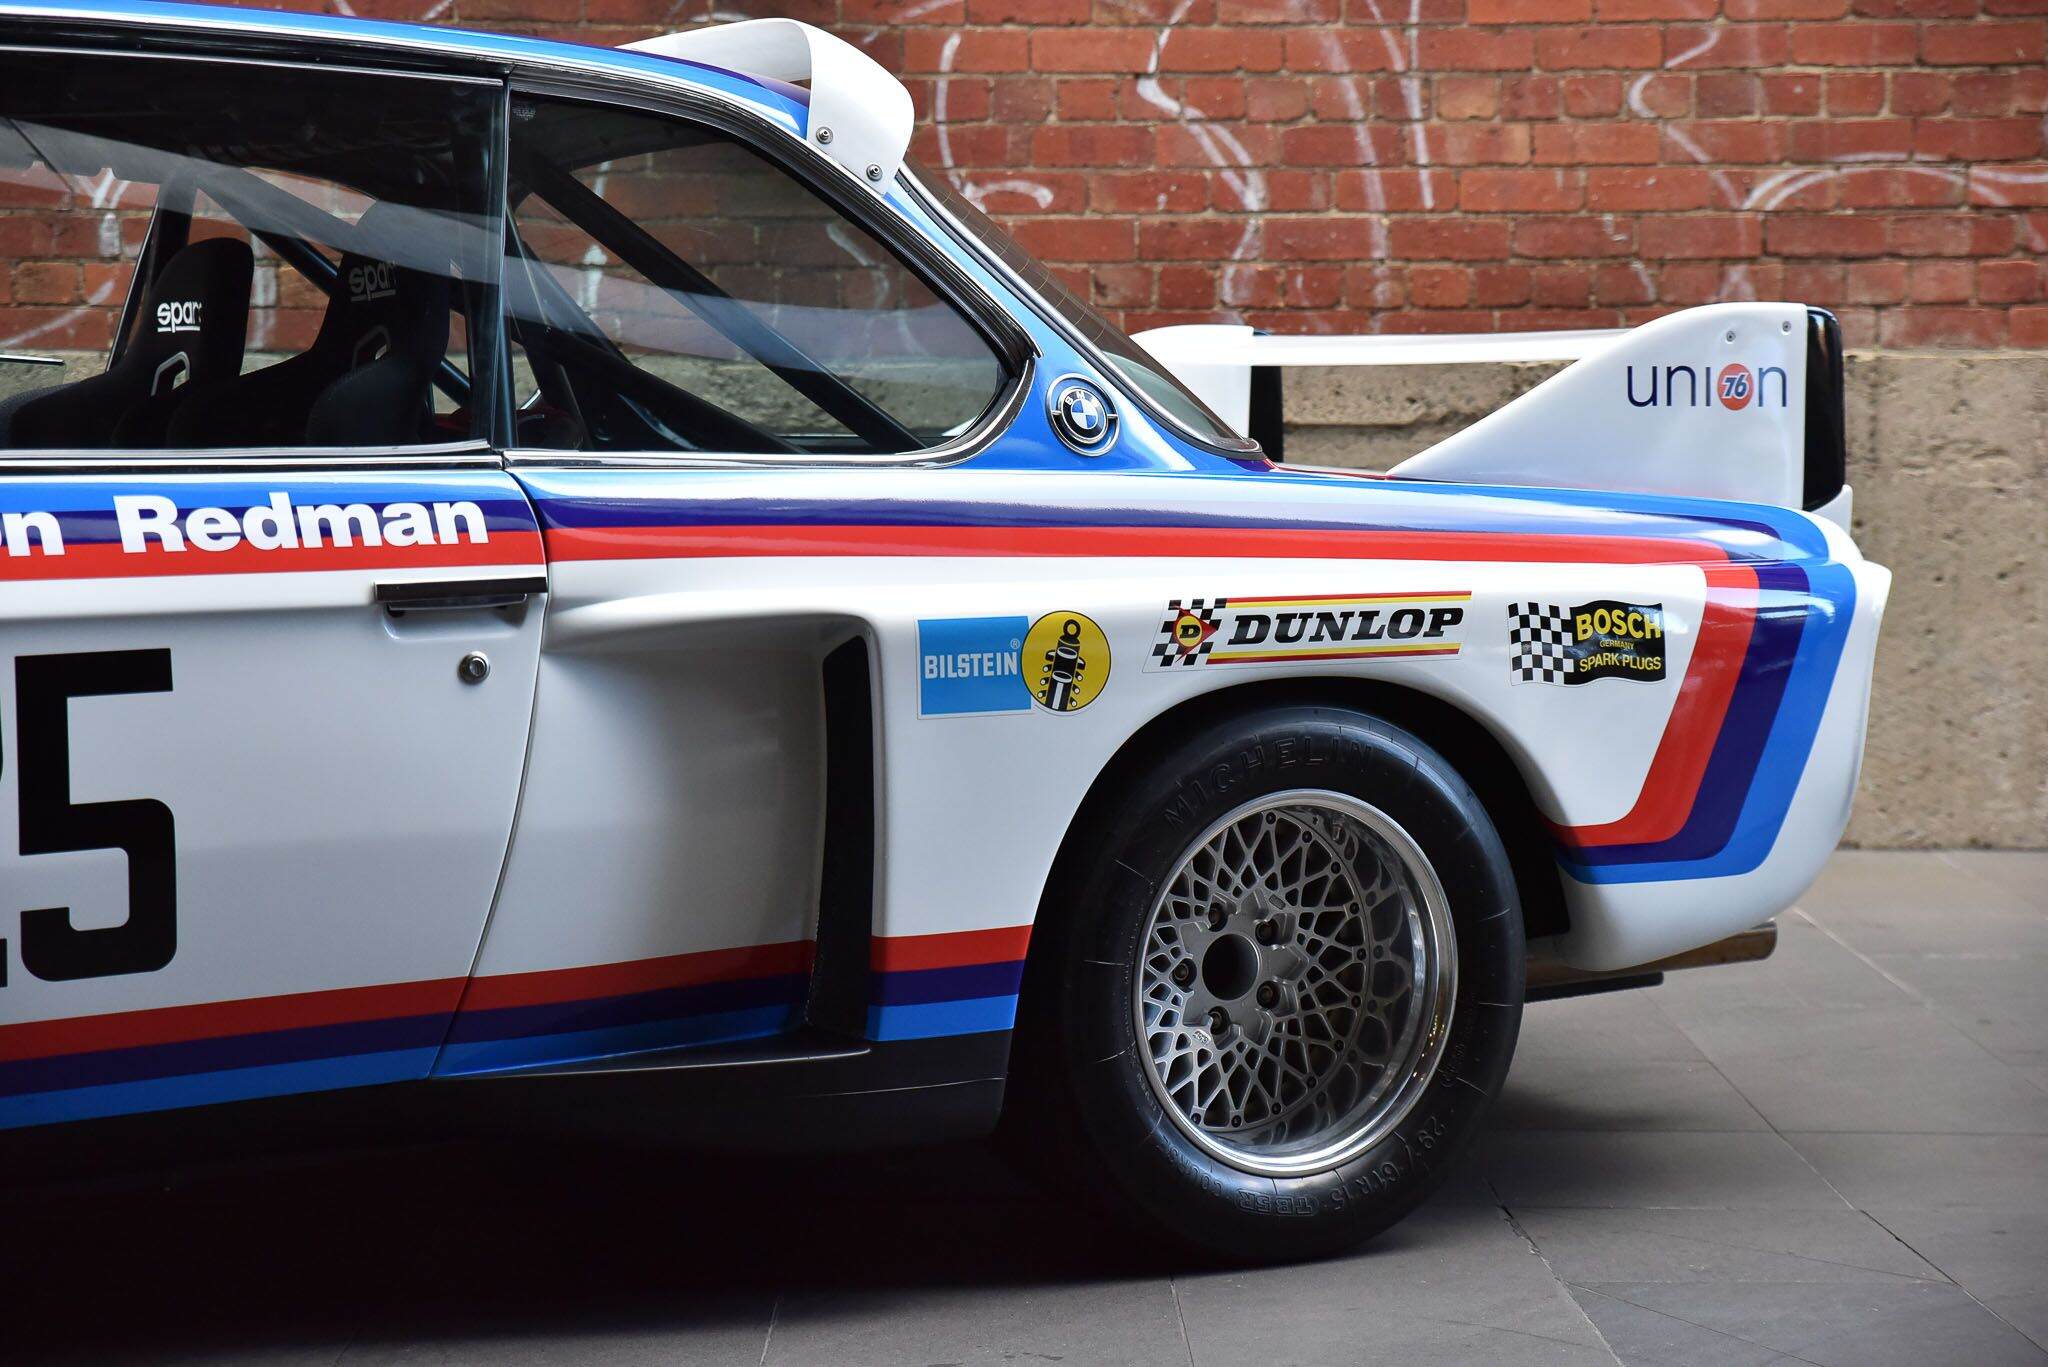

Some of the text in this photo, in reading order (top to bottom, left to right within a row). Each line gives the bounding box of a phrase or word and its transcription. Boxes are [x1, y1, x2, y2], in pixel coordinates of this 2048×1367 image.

[1065, 390, 1100, 407] BMW
[1722, 372, 1749, 399] 76
[0, 492, 489, 556] n Redman
[1179, 624, 1201, 638] D
[1227, 607, 1464, 645] DUNLOP
[1576, 608, 1661, 641] BOSCH
[1599, 640, 1634, 650] GERMANY
[924, 651, 1018, 679] BILSTEIN
[1579, 652, 1662, 673] SPARK PLUGS
[1163, 736, 1373, 832] MICHELIN
[0, 647, 178, 983] 5
